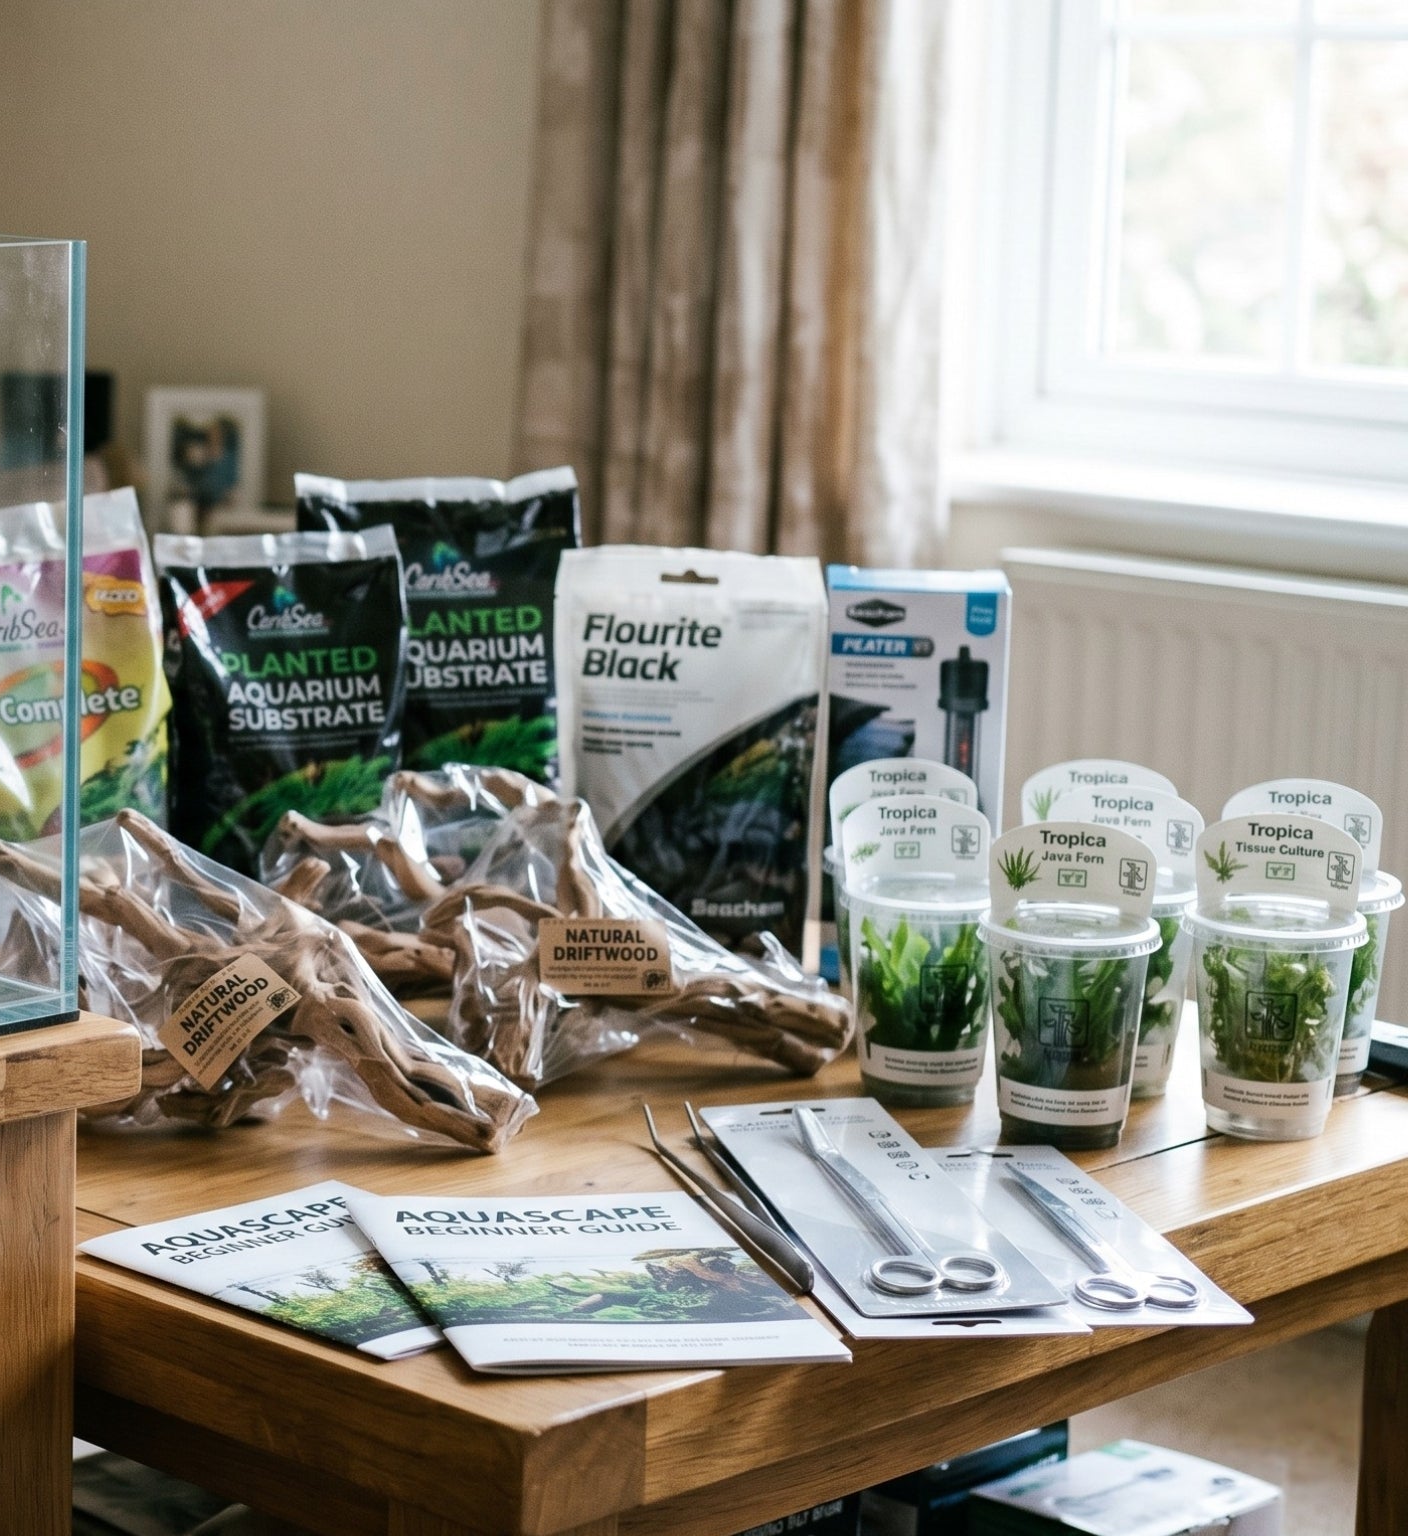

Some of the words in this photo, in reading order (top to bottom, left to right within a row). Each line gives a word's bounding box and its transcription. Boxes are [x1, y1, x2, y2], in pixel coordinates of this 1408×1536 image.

[407, 605, 542, 637] LANTED
[583, 613, 723, 649] Flourite
[406, 633, 545, 666] QUARIUM
[221, 645, 378, 678] PLANTED
[582, 649, 681, 681] Black
[406, 659, 549, 689] UBSTRATE
[228, 674, 382, 708] AQUARIUM
[228, 700, 387, 731] SUBSTRATE
[869, 769, 927, 784] Tropica
[1069, 770, 1129, 785] Tropica
[1092, 795, 1154, 812] Tropica
[1268, 790, 1333, 807] Tropica
[878, 805, 937, 822] Tropica
[1092, 815, 1120, 826] Java
[1123, 816, 1151, 827] Fern
[879, 826, 906, 836] Java
[909, 827, 936, 835] Fern
[1040, 830, 1106, 849] Tropica
[1248, 822, 1314, 841] Tropica
[1041, 850, 1072, 862] Java
[1076, 851, 1104, 864] Fern
[1235, 841, 1276, 855] Tissue
[1279, 844, 1324, 858] Culture
[566, 929, 645, 944] NATURAL
[554, 946, 658, 962] DRIFTWOOD
[180, 974, 248, 1033] NATURAL
[182, 977, 269, 1057] DRIFTWOOD
[395, 1205, 672, 1225] AQUASCAPE
[141, 1196, 347, 1256] AQUASCAPE
[403, 1225, 571, 1236] BEGINNER
[577, 1221, 683, 1235] GUIDE
[169, 1229, 305, 1265] BEGINNER
[303, 1214, 355, 1233] GUI
